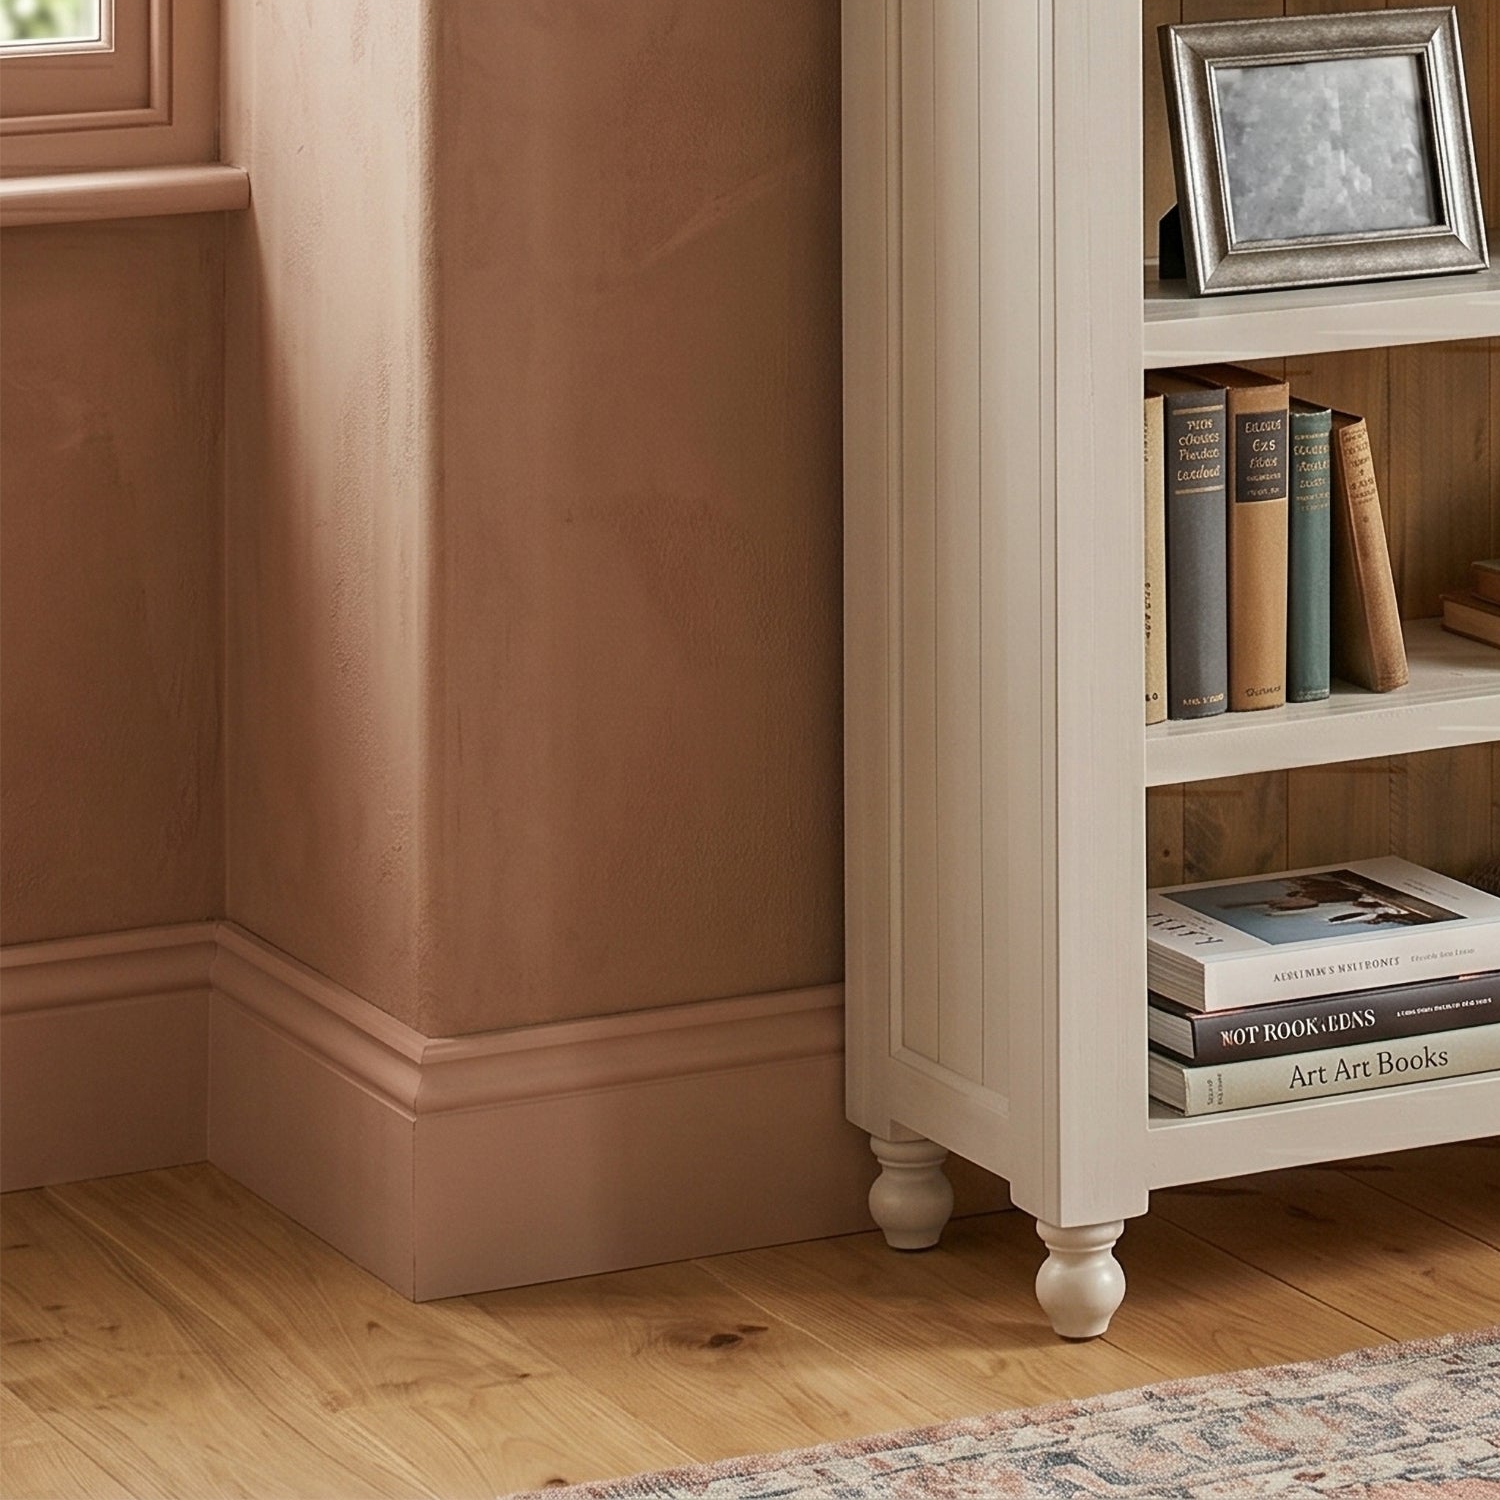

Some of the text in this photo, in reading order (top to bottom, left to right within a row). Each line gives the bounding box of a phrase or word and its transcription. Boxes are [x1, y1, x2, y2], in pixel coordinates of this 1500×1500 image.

[1289, 1046, 1449, 1089] Art Art Books
